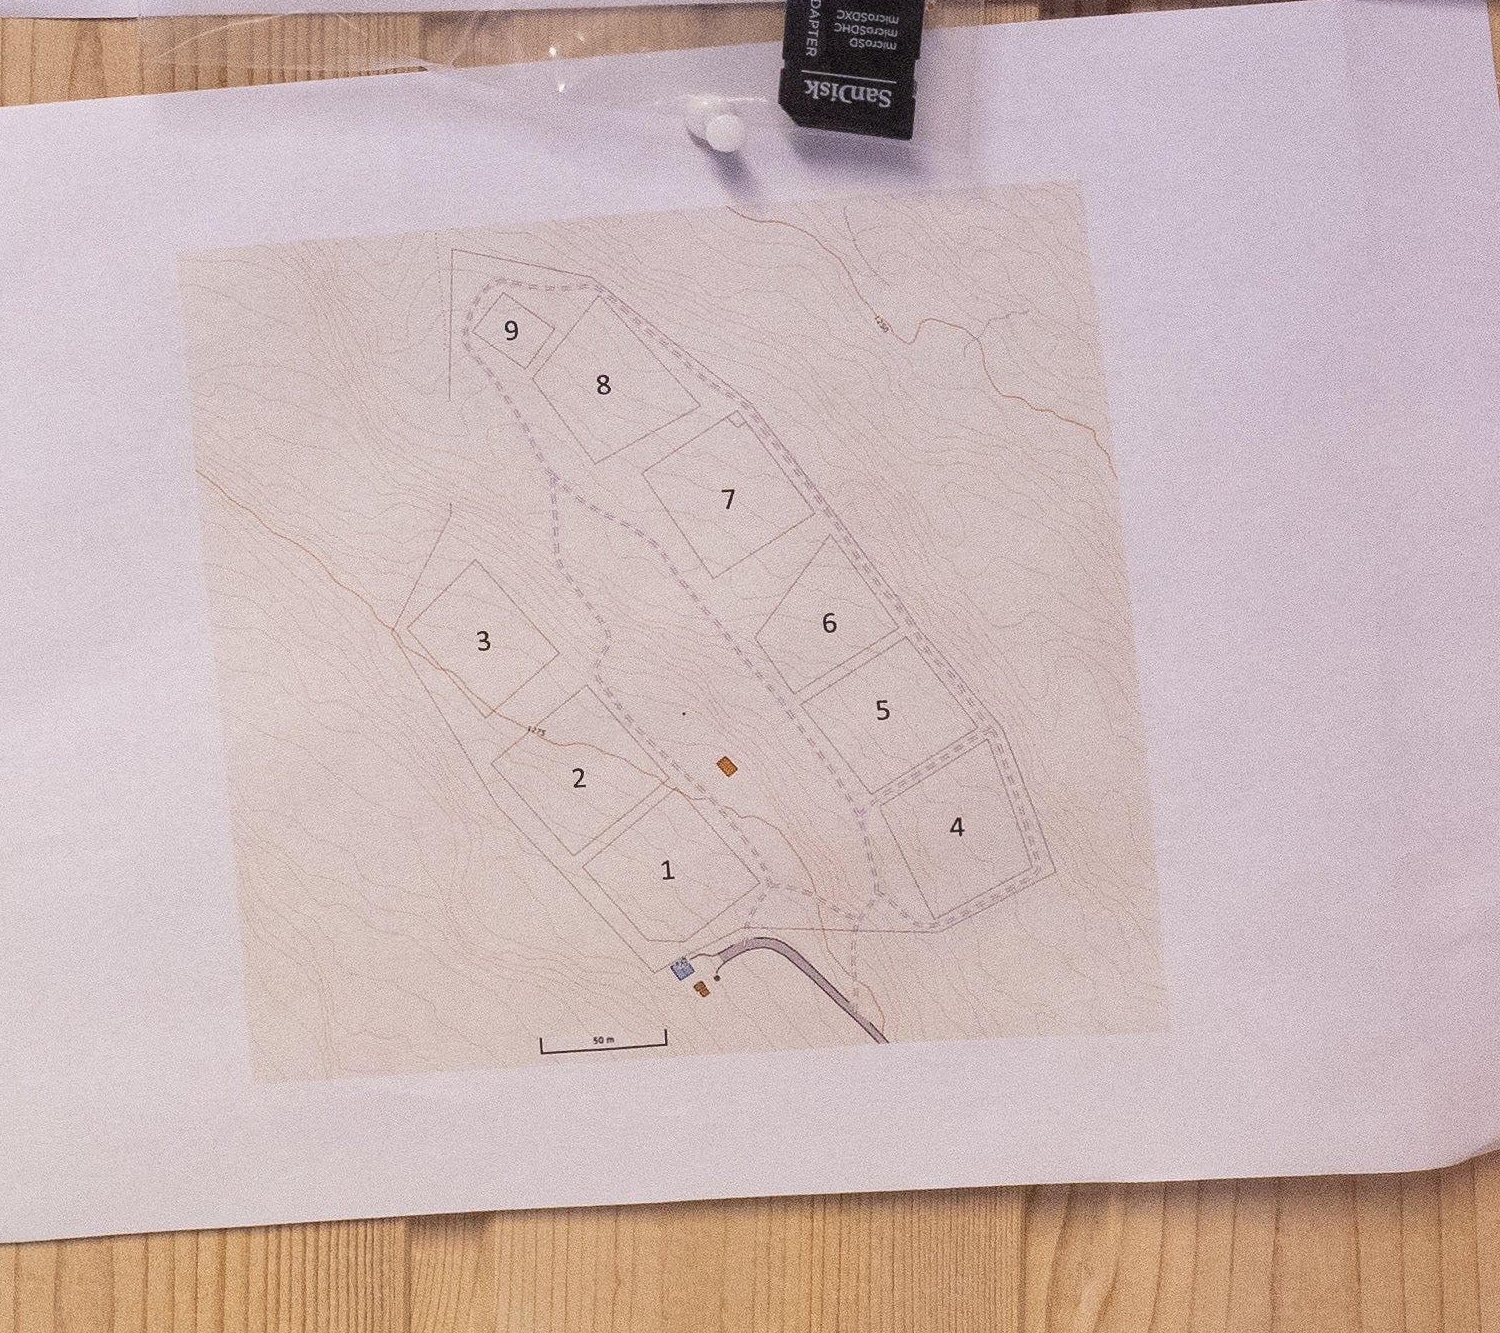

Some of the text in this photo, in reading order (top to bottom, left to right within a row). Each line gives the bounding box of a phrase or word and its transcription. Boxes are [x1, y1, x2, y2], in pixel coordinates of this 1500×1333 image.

[804, 78, 892, 108] SanDisk
[504, 320, 519, 342] 9
[596, 374, 612, 396] 8
[721, 488, 736, 510] 7
[822, 612, 838, 634] 6
[476, 630, 491, 652] 3
[875, 699, 891, 721] 5
[572, 767, 587, 789] 2
[949, 816, 965, 837] 4
[661, 859, 675, 881] 1
